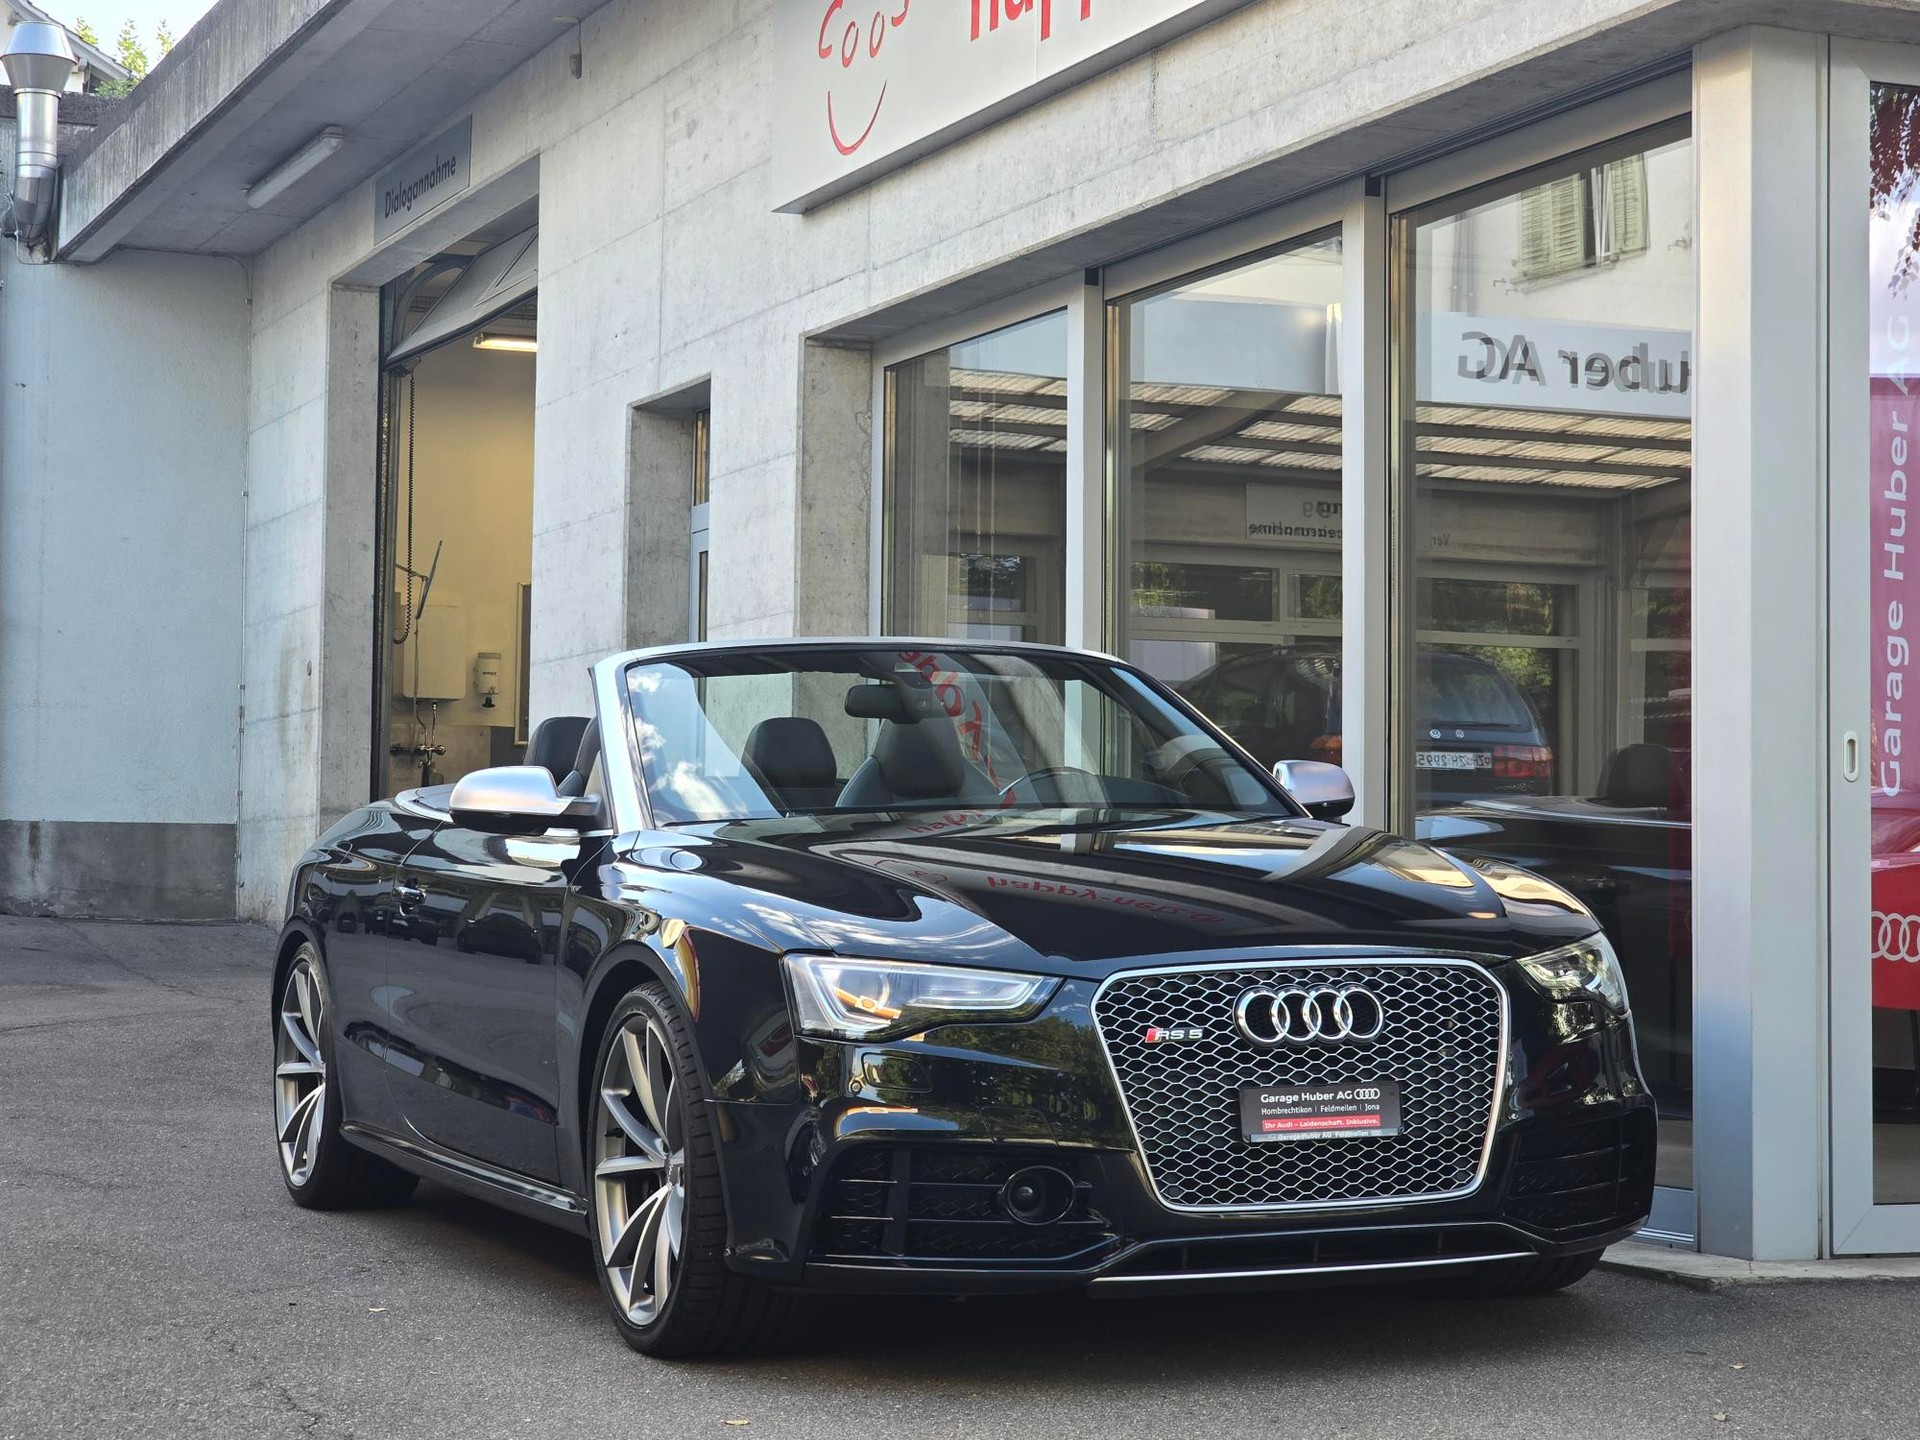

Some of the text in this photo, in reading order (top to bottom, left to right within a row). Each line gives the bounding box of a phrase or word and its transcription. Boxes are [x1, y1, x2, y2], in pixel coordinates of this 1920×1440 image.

[385, 155, 457, 219] Dialogannahme
[1881, 315, 1910, 797] Garage Huber AG
[1155, 1028, 1203, 1041] RS 5
[1260, 1091, 1353, 1104] Garage Huber AG
[1261, 1103, 1380, 1116] Hombrechtikon Feldmeilen Jona
